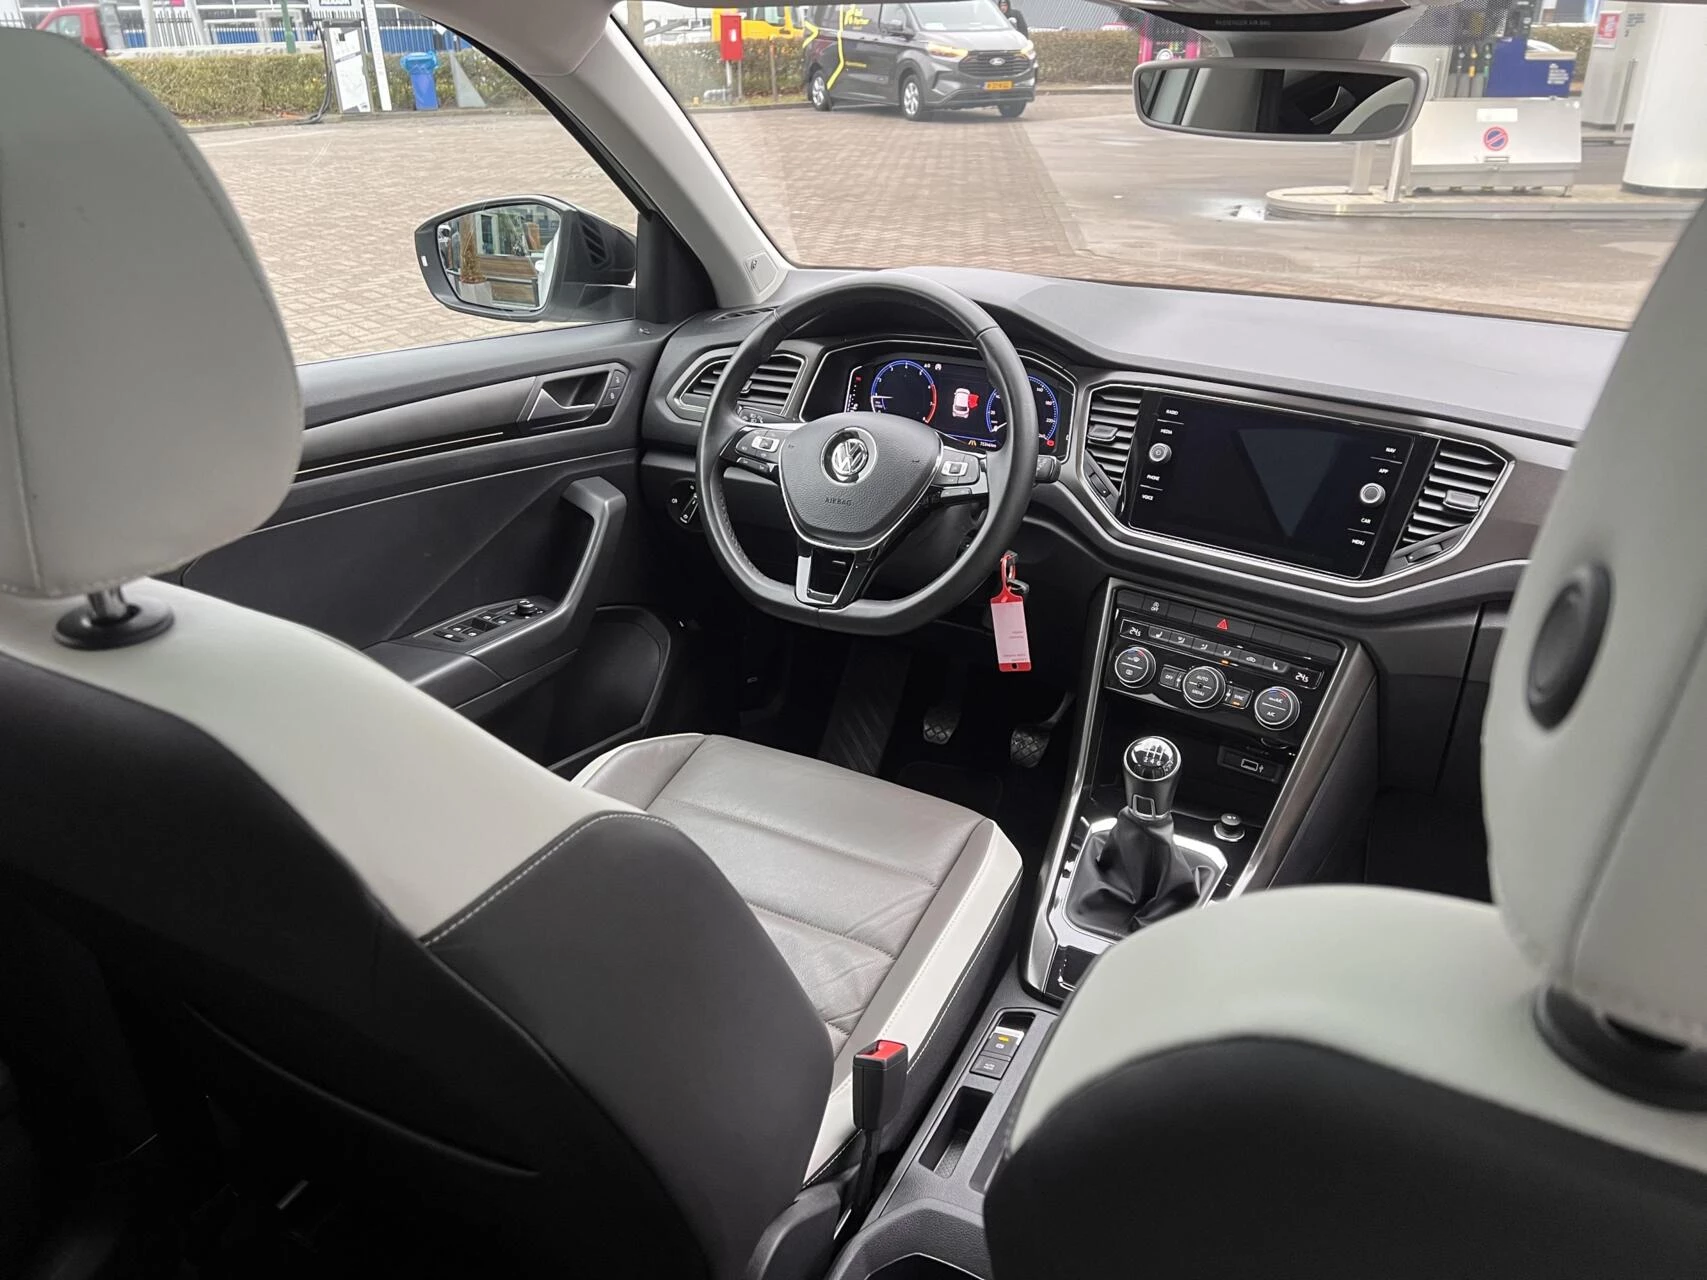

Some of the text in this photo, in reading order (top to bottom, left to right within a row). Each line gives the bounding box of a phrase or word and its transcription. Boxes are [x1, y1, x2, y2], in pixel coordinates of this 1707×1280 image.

[824, 496, 853, 507] AIRBAG
[1351, 538, 1366, 546] MENU
[1191, 689, 1205, 697] MENU
